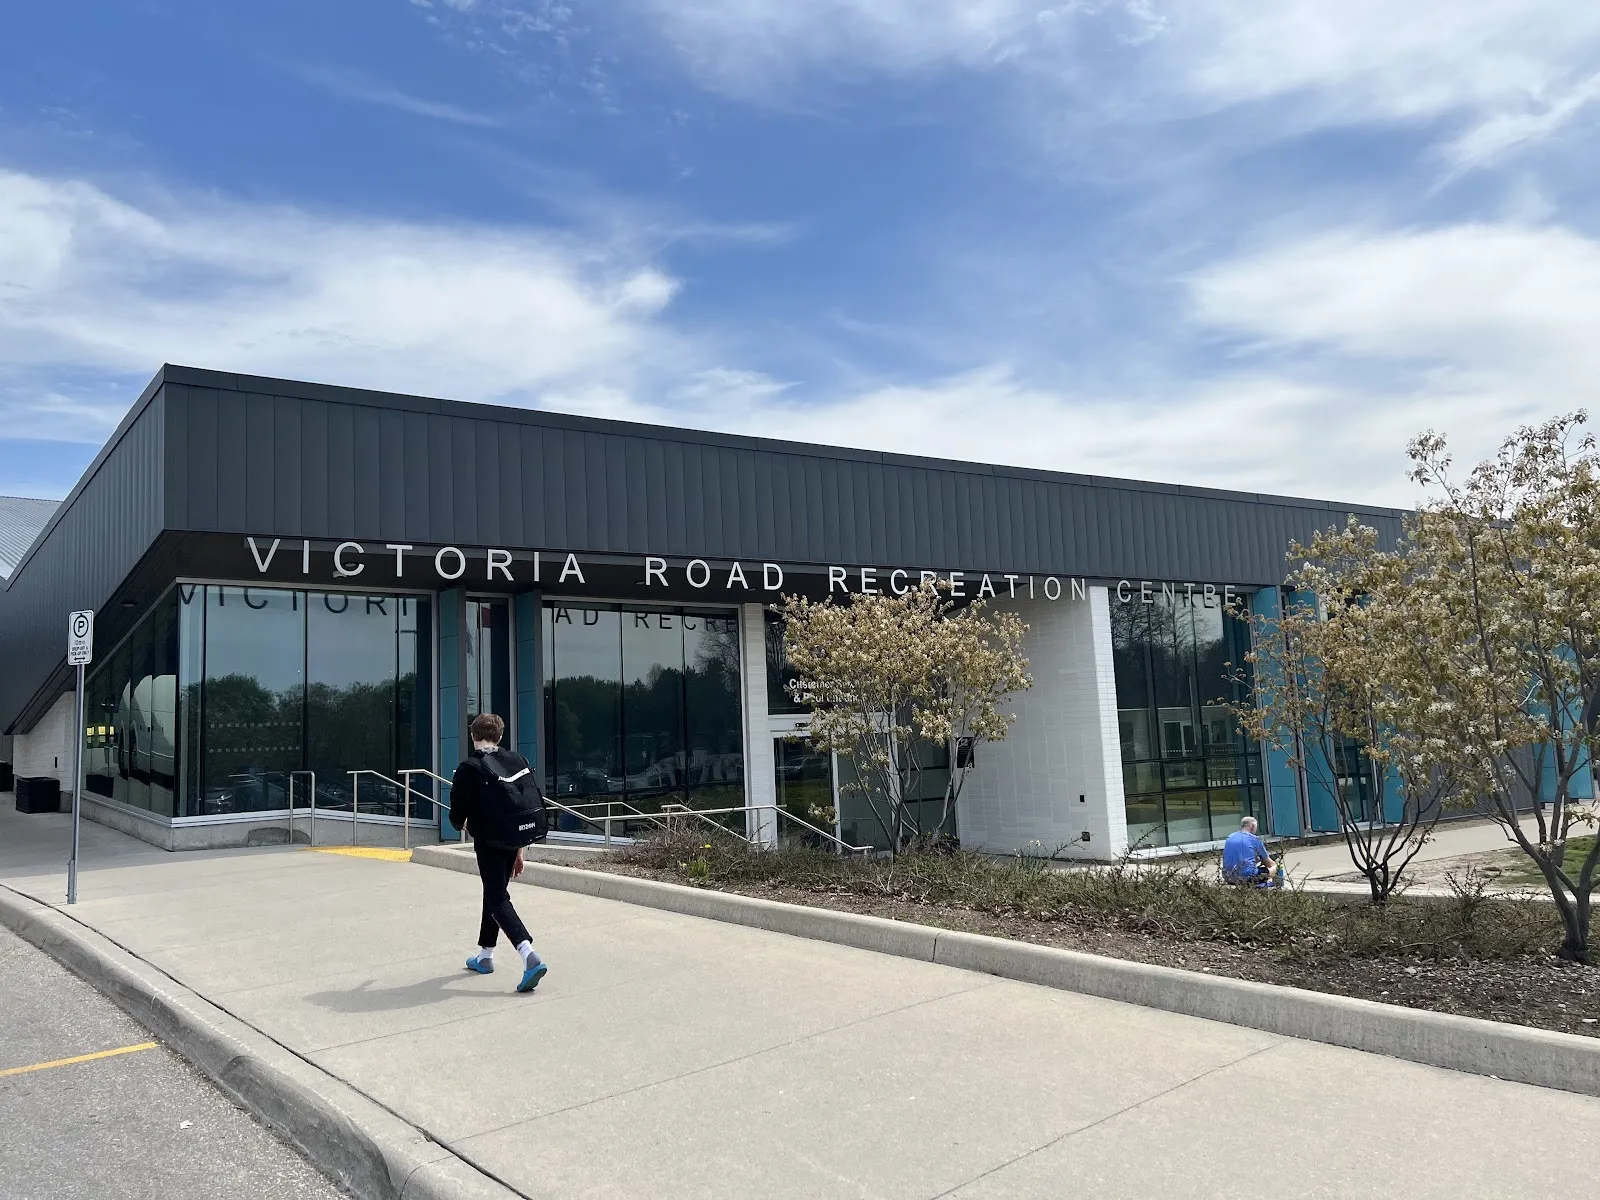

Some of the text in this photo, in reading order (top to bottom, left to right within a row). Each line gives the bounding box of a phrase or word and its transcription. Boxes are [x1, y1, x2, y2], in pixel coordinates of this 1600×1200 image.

[246, 536, 586, 584] VICTORIA
[645, 556, 784, 591] ROAD
[828, 565, 1087, 601] RECREATION
[1116, 579, 1237, 607] CENTRE
[793, 691, 801, 703] &
